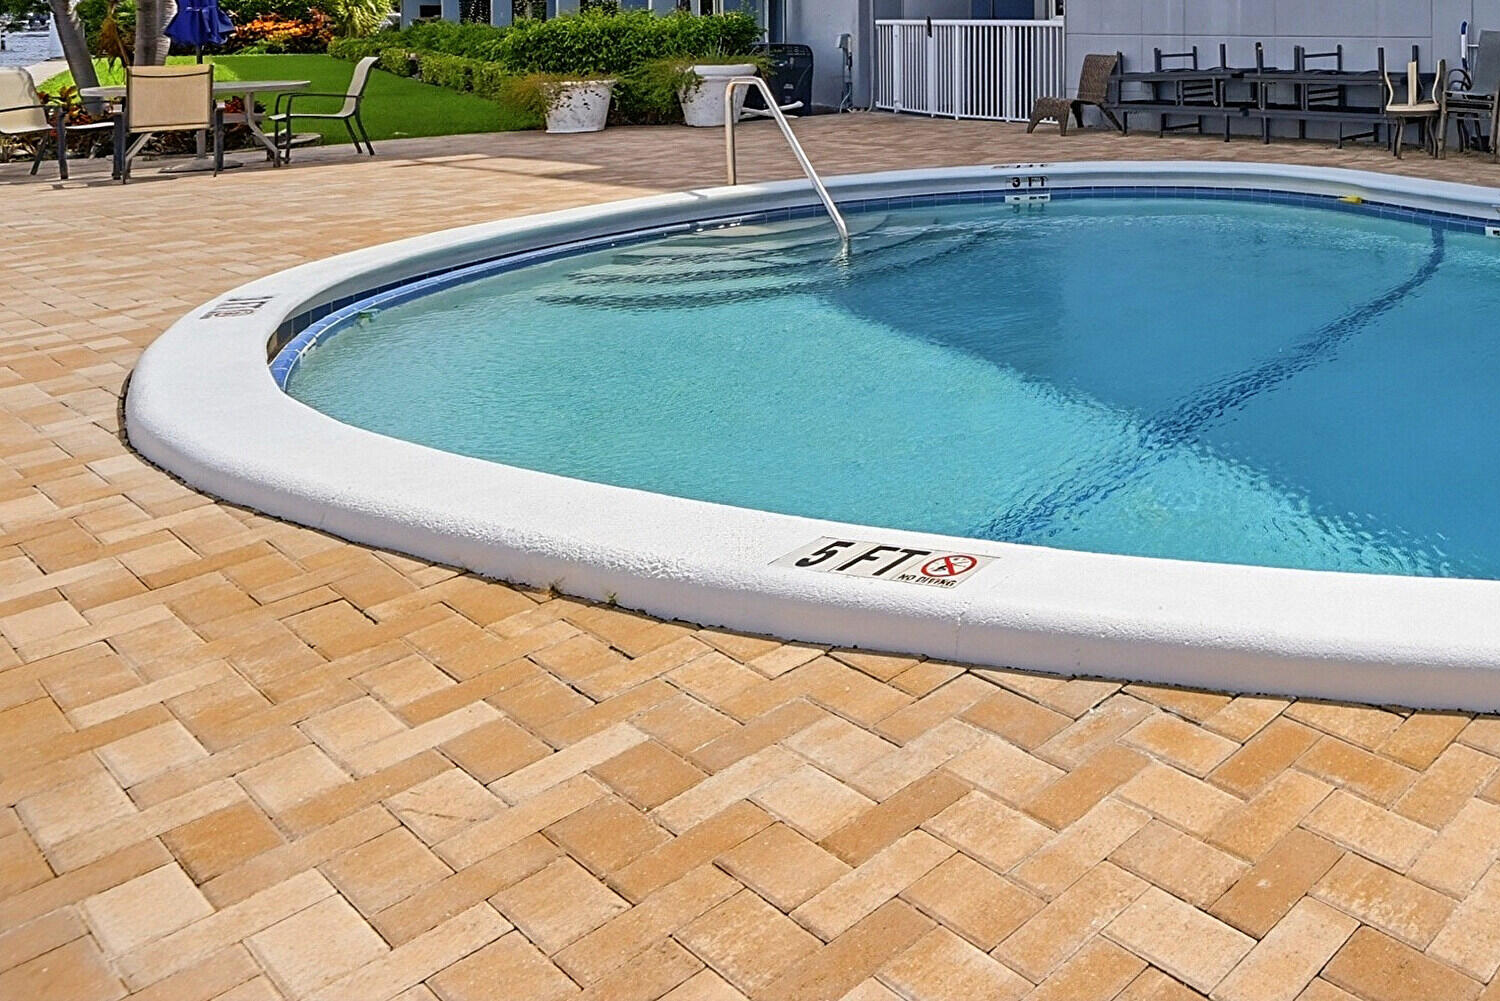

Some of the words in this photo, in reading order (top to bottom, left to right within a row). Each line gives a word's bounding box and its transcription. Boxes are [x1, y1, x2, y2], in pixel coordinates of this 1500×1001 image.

[794, 540, 856, 568] 5
[836, 545, 931, 576] FT
[898, 573, 917, 581] NO
